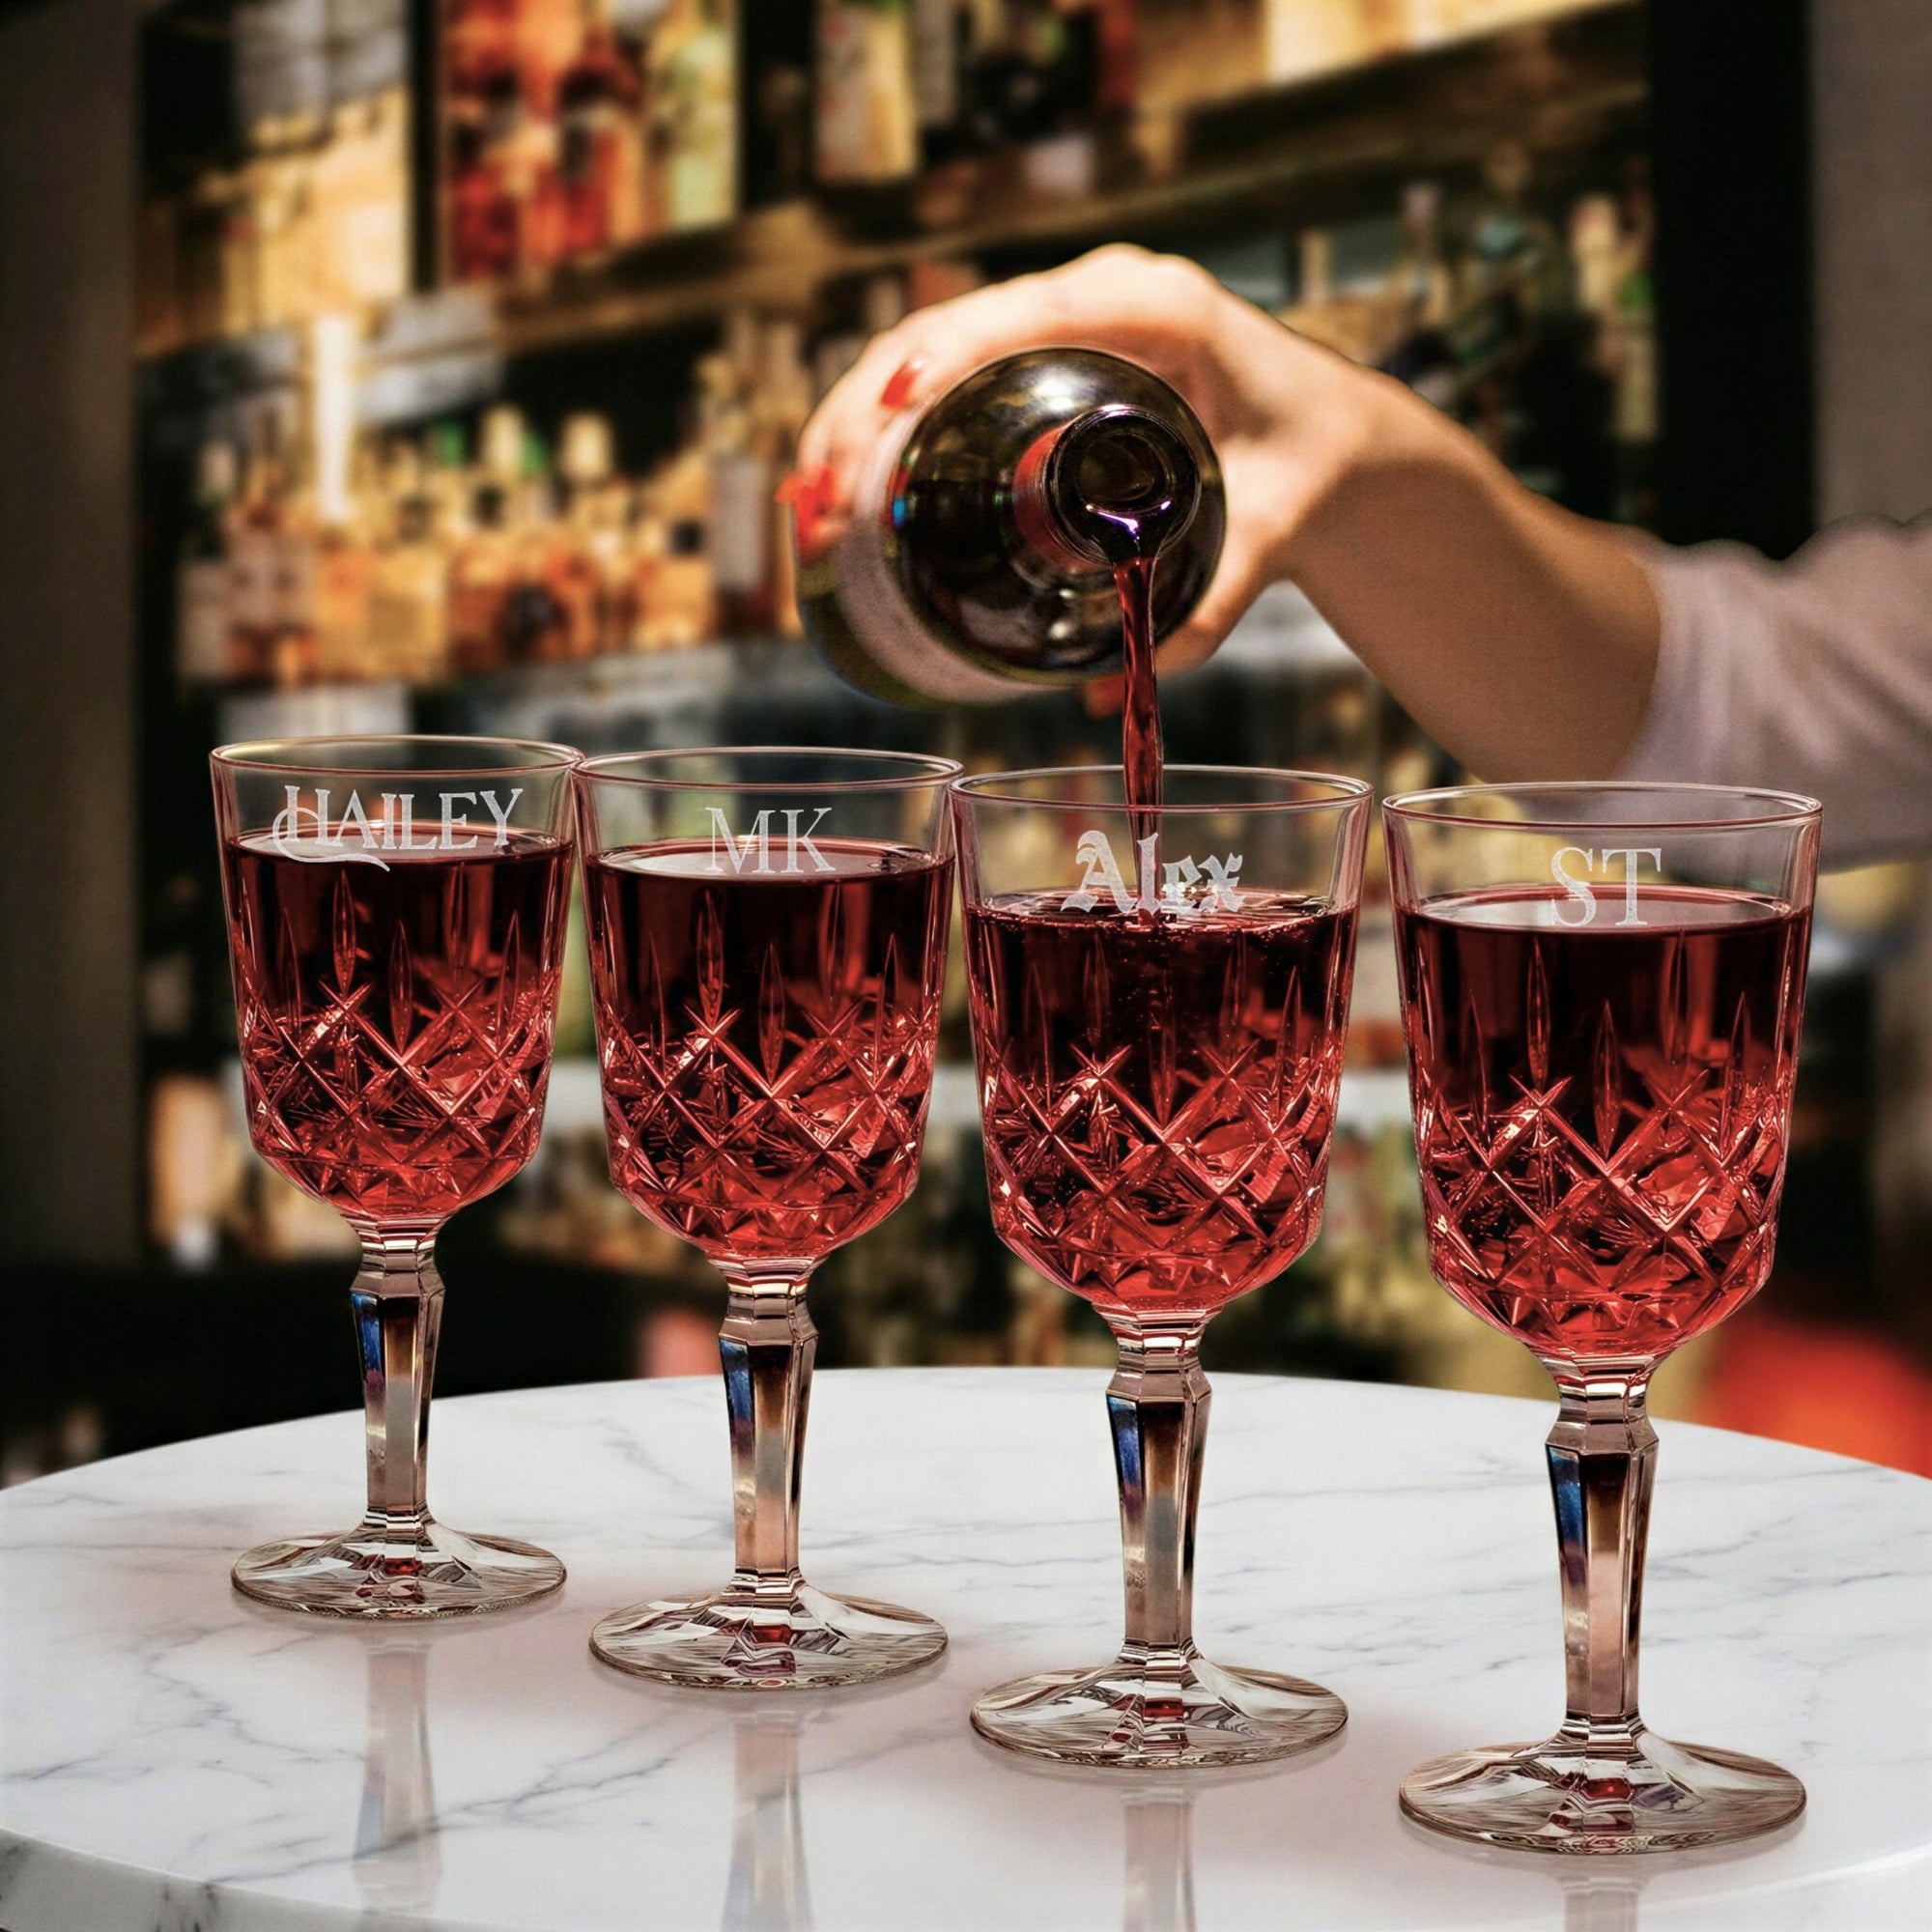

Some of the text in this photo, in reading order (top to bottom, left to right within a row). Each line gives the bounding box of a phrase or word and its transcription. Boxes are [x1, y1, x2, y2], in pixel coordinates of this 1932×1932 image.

[271, 784, 524, 872] HAILEY
[705, 808, 836, 873] MK
[1060, 830, 1246, 916] Alex
[1551, 847, 1662, 926] ST
